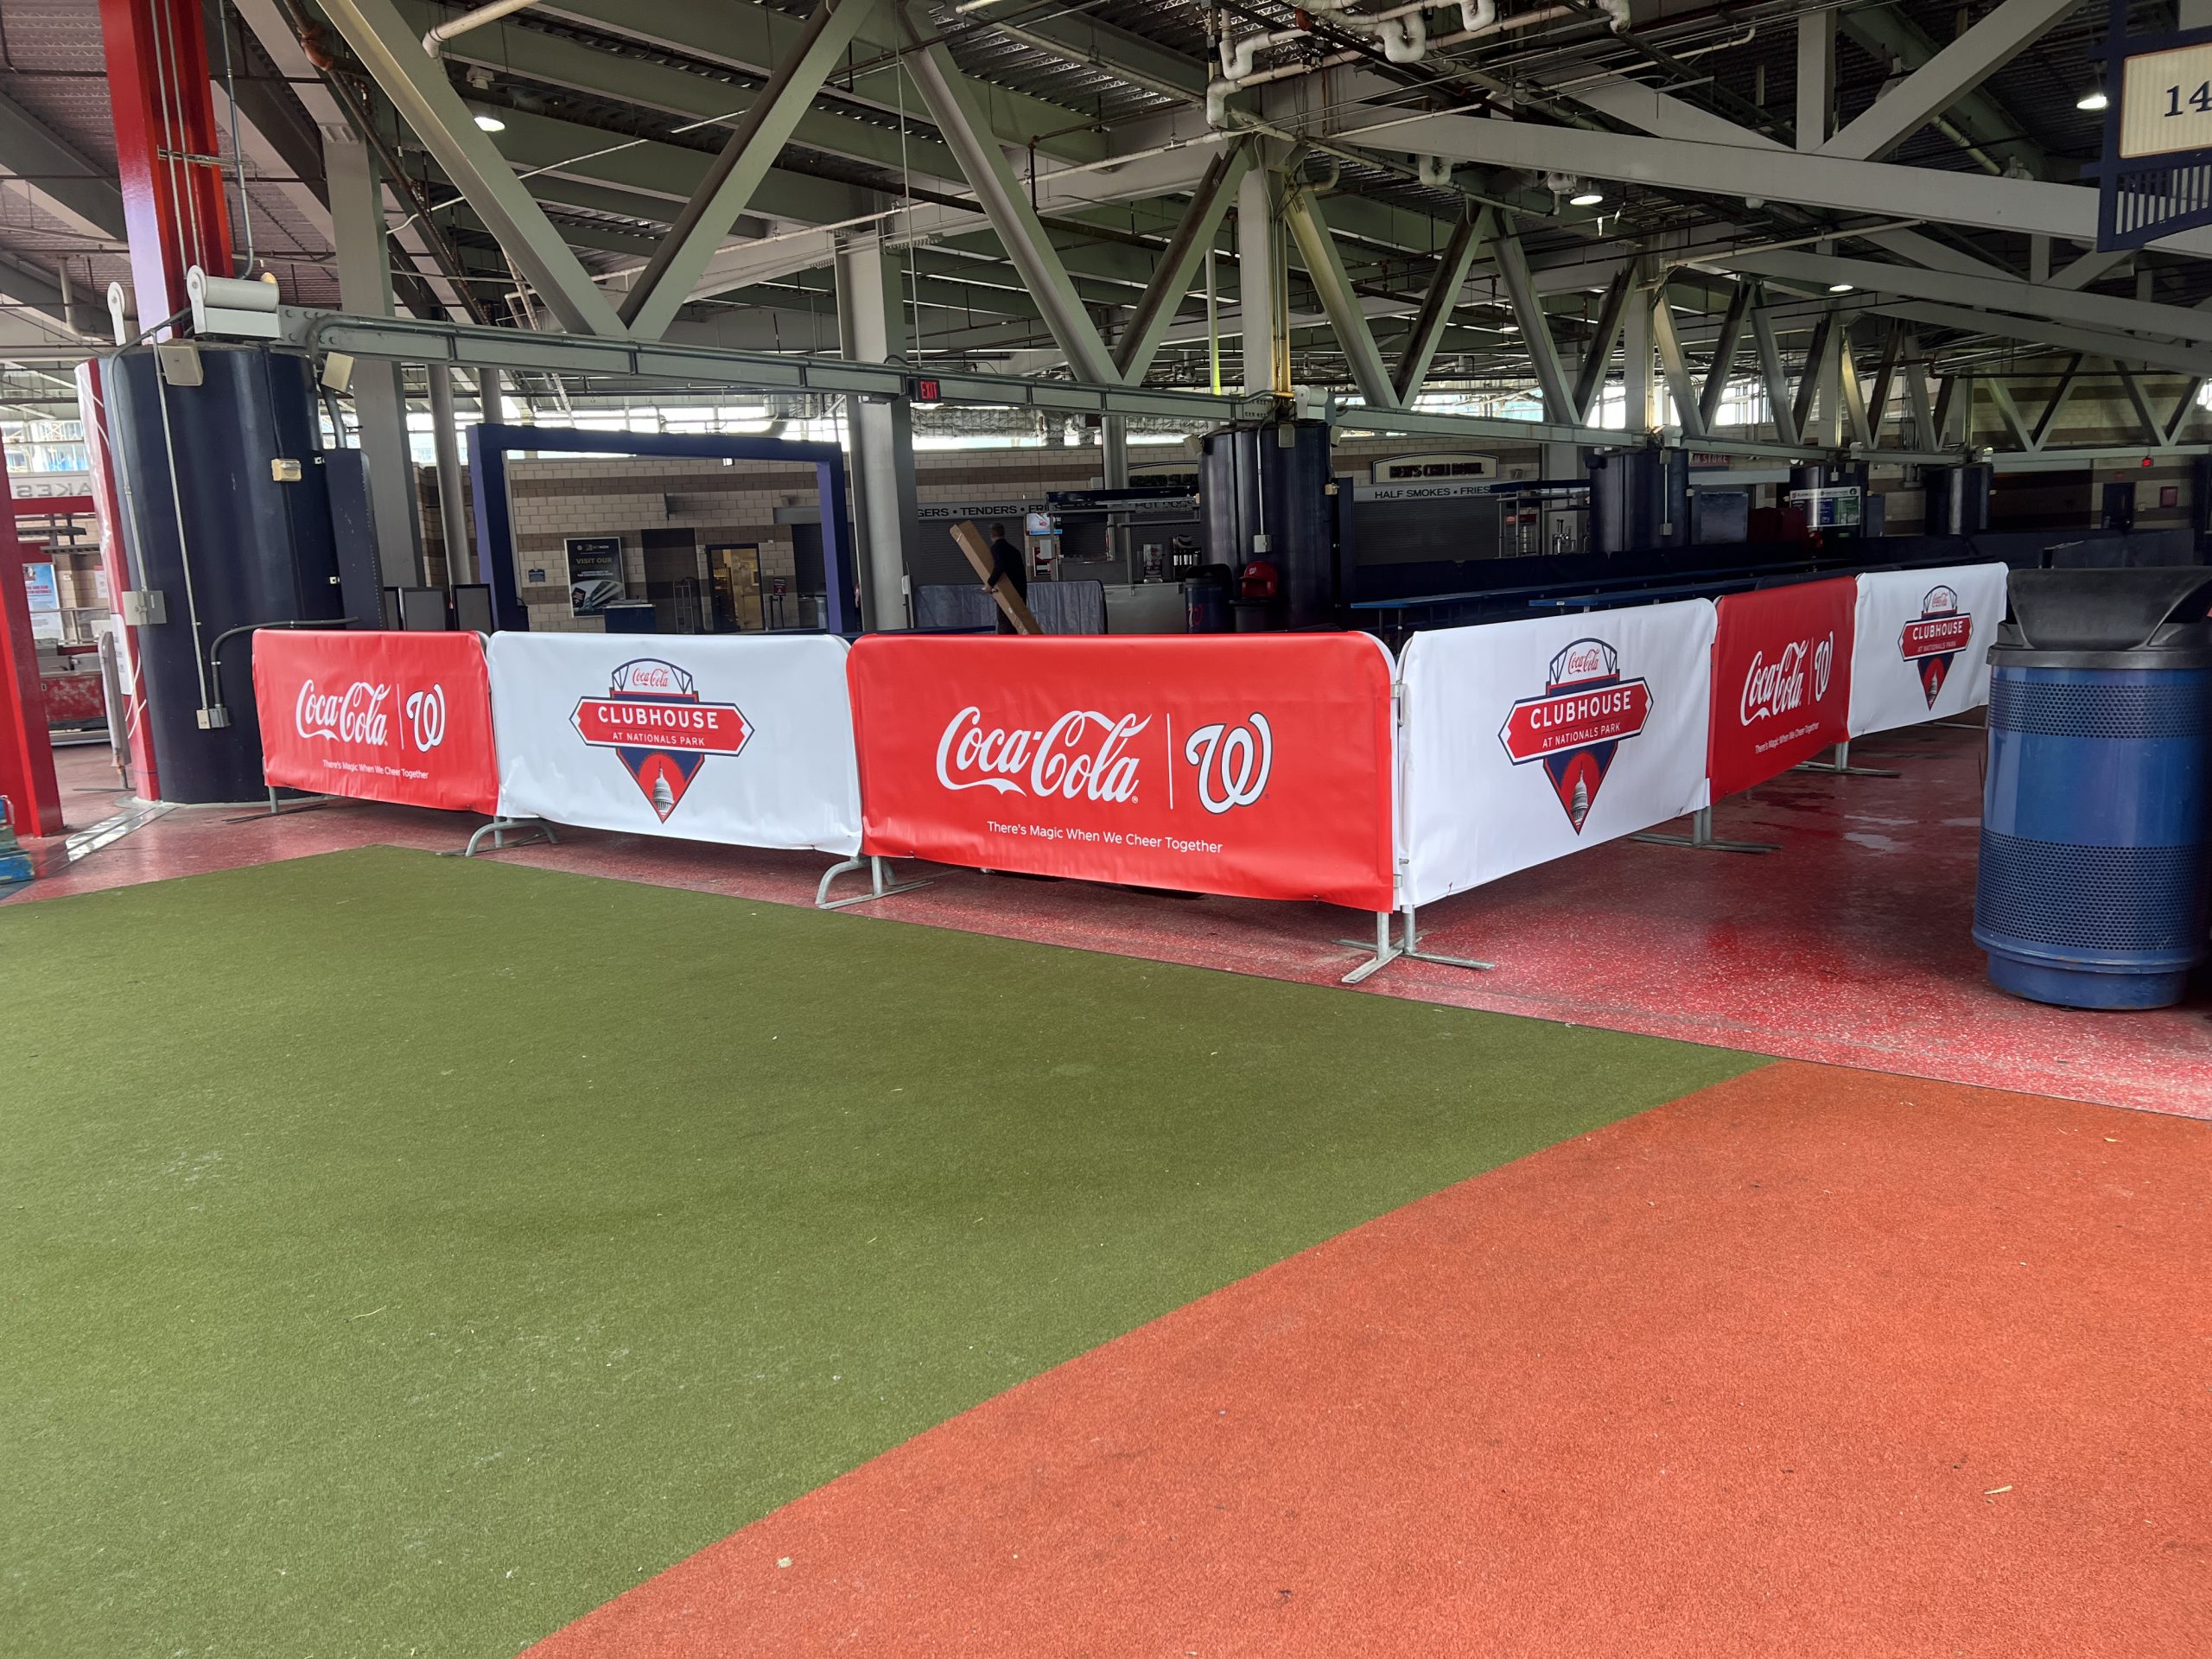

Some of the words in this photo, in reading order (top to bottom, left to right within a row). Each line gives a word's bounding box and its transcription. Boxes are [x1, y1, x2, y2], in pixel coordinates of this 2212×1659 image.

[920, 381, 938, 399] EXIT
[1703, 454, 1727, 464] STORE
[1375, 490, 1404, 499] HALF
[1406, 487, 1451, 497] SMOKES
[1460, 486, 1491, 495] FRIES
[960, 505, 1017, 516] TENDERS
[1912, 620, 1963, 640] CLUBHOUSE
[1567, 649, 1600, 675] Coca-Cola
[632, 667, 670, 687] Coca-Cola
[1740, 639, 1809, 727] Coca-Cola
[296, 679, 391, 746] Coca-Cola
[405, 683, 446, 753] W
[598, 706, 719, 729] CLUBHOUSE
[1530, 690, 1631, 729] CLUBHOUSE
[626, 733, 677, 745] NATIONALS
[680, 737, 705, 747] PARK
[1542, 736, 1553, 748] AT
[1554, 728, 1599, 746] NATIONALS
[1600, 721, 1621, 734] PARK
[322, 760, 341, 770] There's
[342, 761, 358, 772] Magic
[359, 764, 374, 773] When
[374, 766, 385, 774] We
[385, 766, 400, 776] Cheer
[401, 768, 429, 779] Together
[936, 706, 1153, 804] Coca-Cola
[1185, 711, 1273, 815] W
[987, 821, 1027, 836] There's
[1029, 825, 1064, 841] Magic
[1065, 829, 1100, 842] When
[1103, 831, 1122, 843] We
[1125, 834, 1162, 848] Cheer
[1165, 836, 1223, 854] Together
